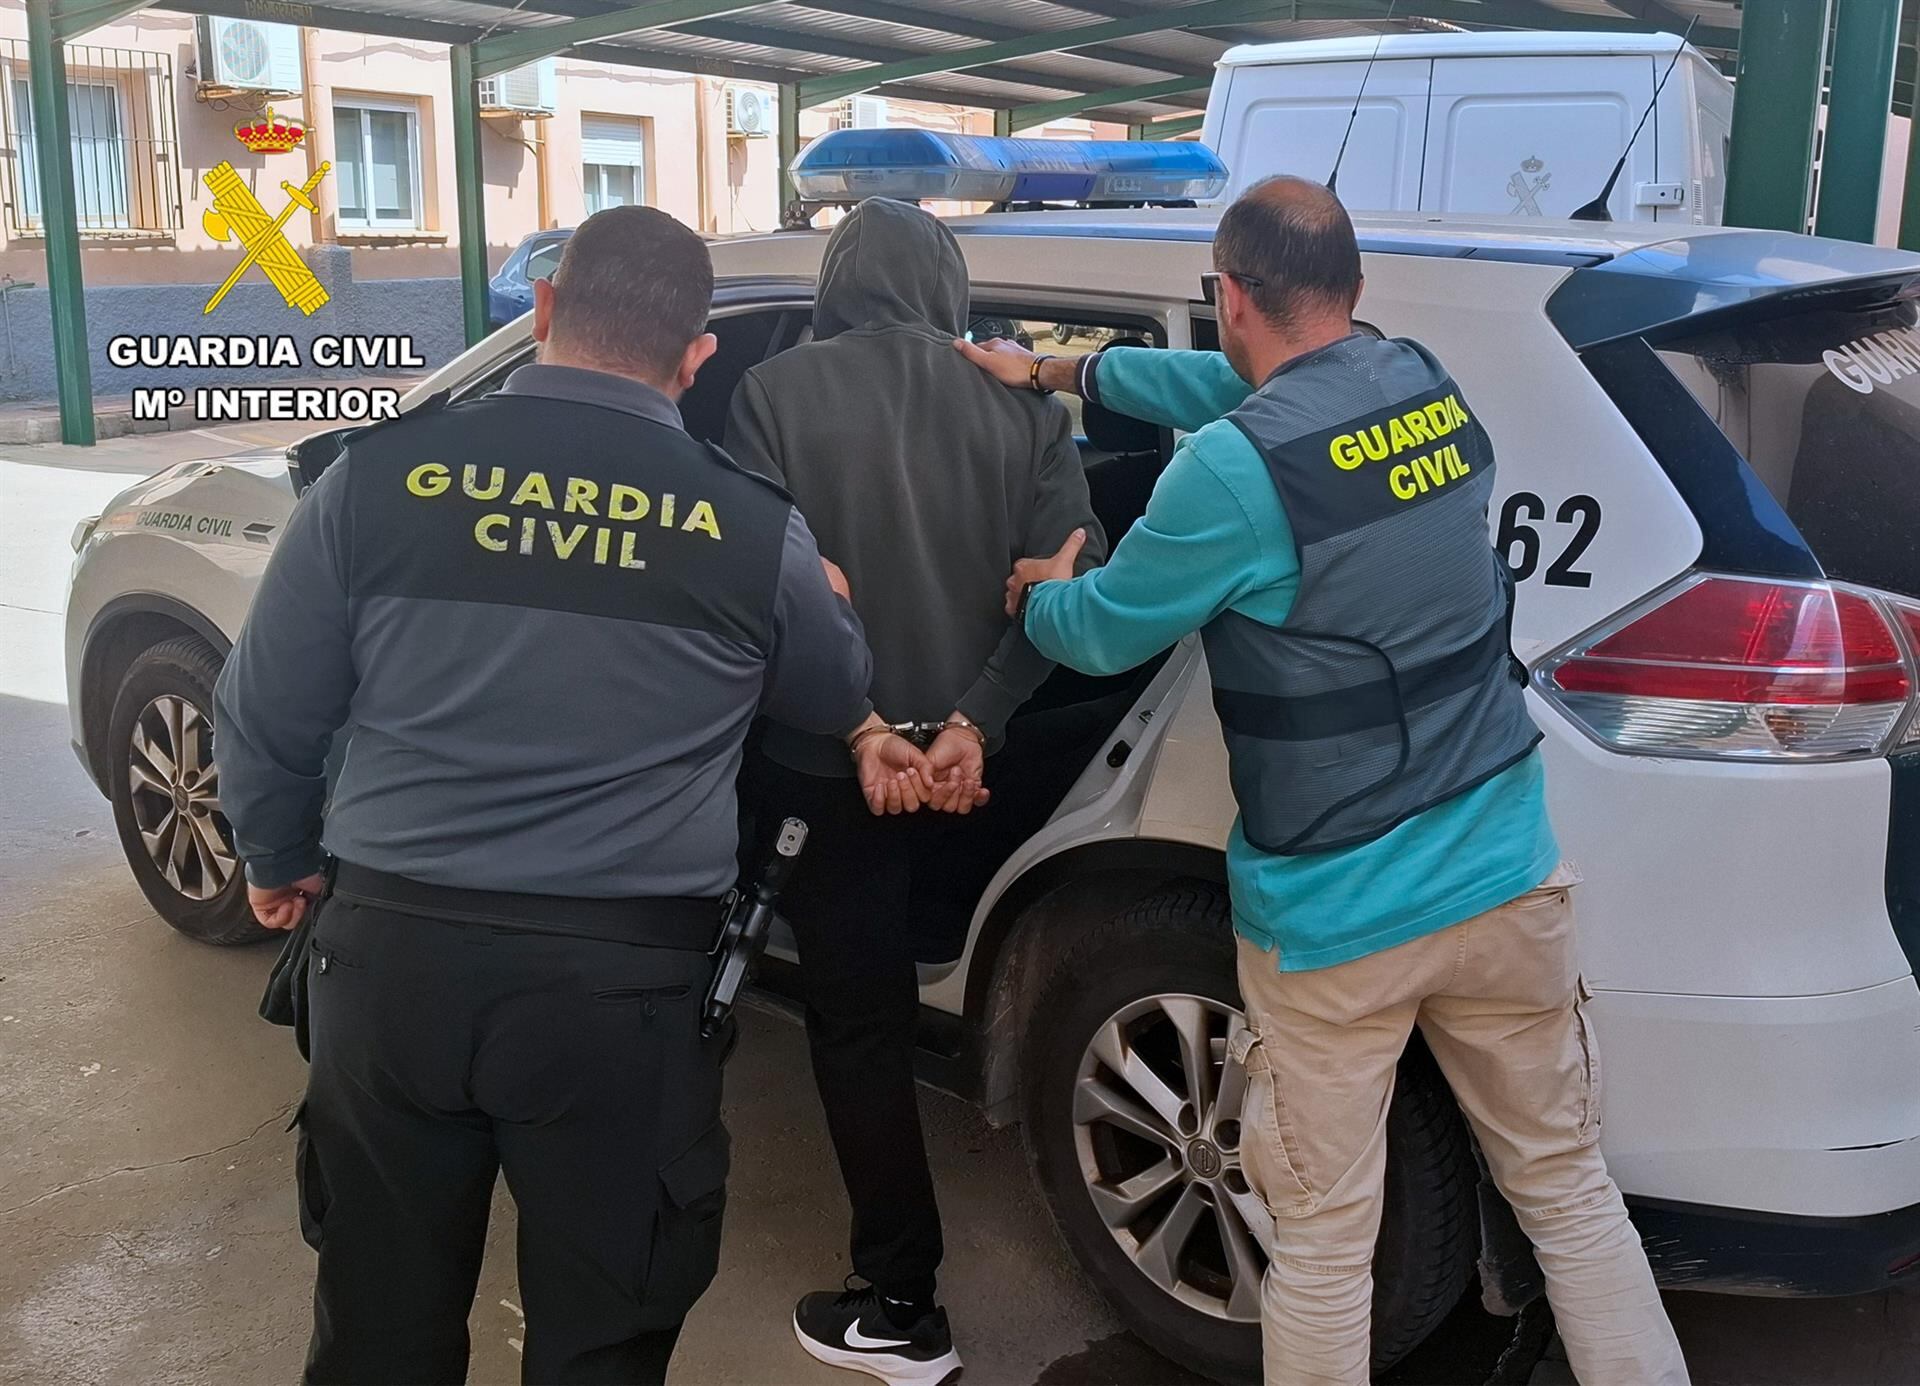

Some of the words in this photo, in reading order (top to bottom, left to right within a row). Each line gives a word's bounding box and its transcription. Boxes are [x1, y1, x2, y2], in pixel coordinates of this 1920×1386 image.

[1330, 394, 1468, 470] GUARDIA
[406, 463, 722, 540] GUARDIA
[1389, 443, 1471, 500] CIVIL
[135, 511, 194, 532] GUARDIA
[196, 515, 233, 538] CIVIL
[474, 513, 647, 570] CIVIL
[1484, 491, 1601, 589] 62
